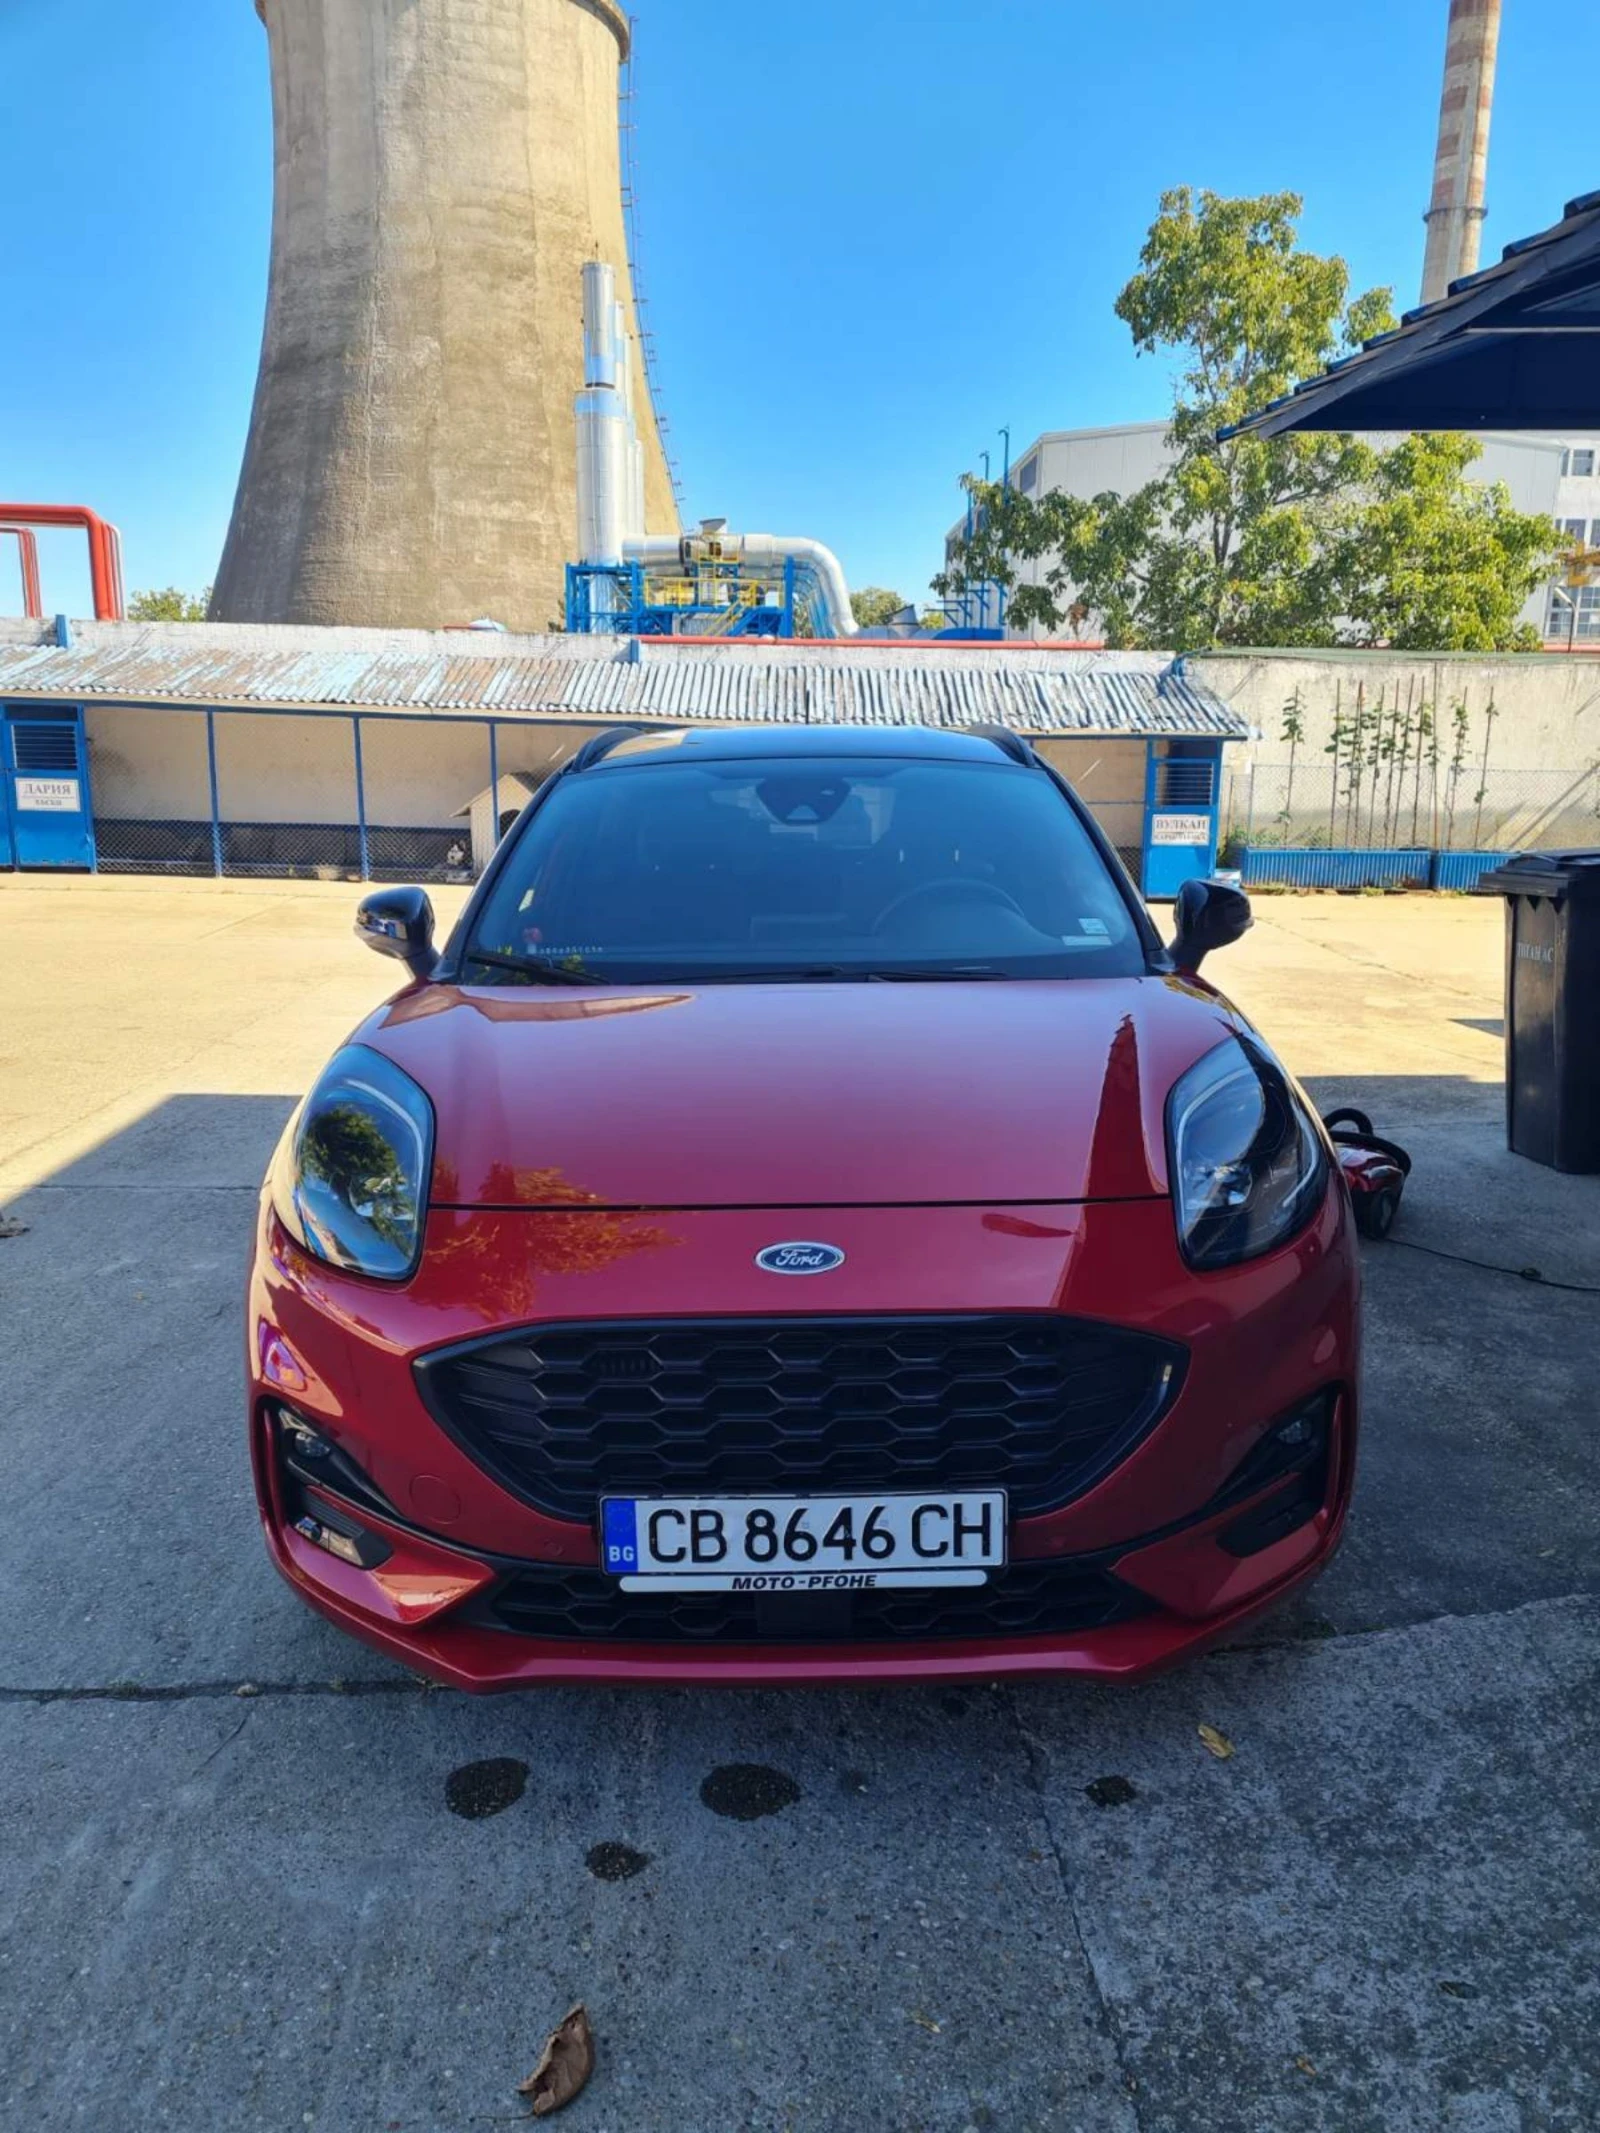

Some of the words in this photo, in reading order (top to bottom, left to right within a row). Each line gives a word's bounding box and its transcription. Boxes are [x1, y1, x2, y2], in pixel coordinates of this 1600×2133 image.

[23, 783, 72, 795] ДАРИЯ
[1156, 819, 1207, 830] ВУЛКАН
[775, 1248, 825, 1266] Ford
[648, 1508, 728, 1563] CB
[743, 1505, 897, 1563] 8646
[911, 1502, 992, 1558] CH
[608, 1545, 635, 1562] BG
